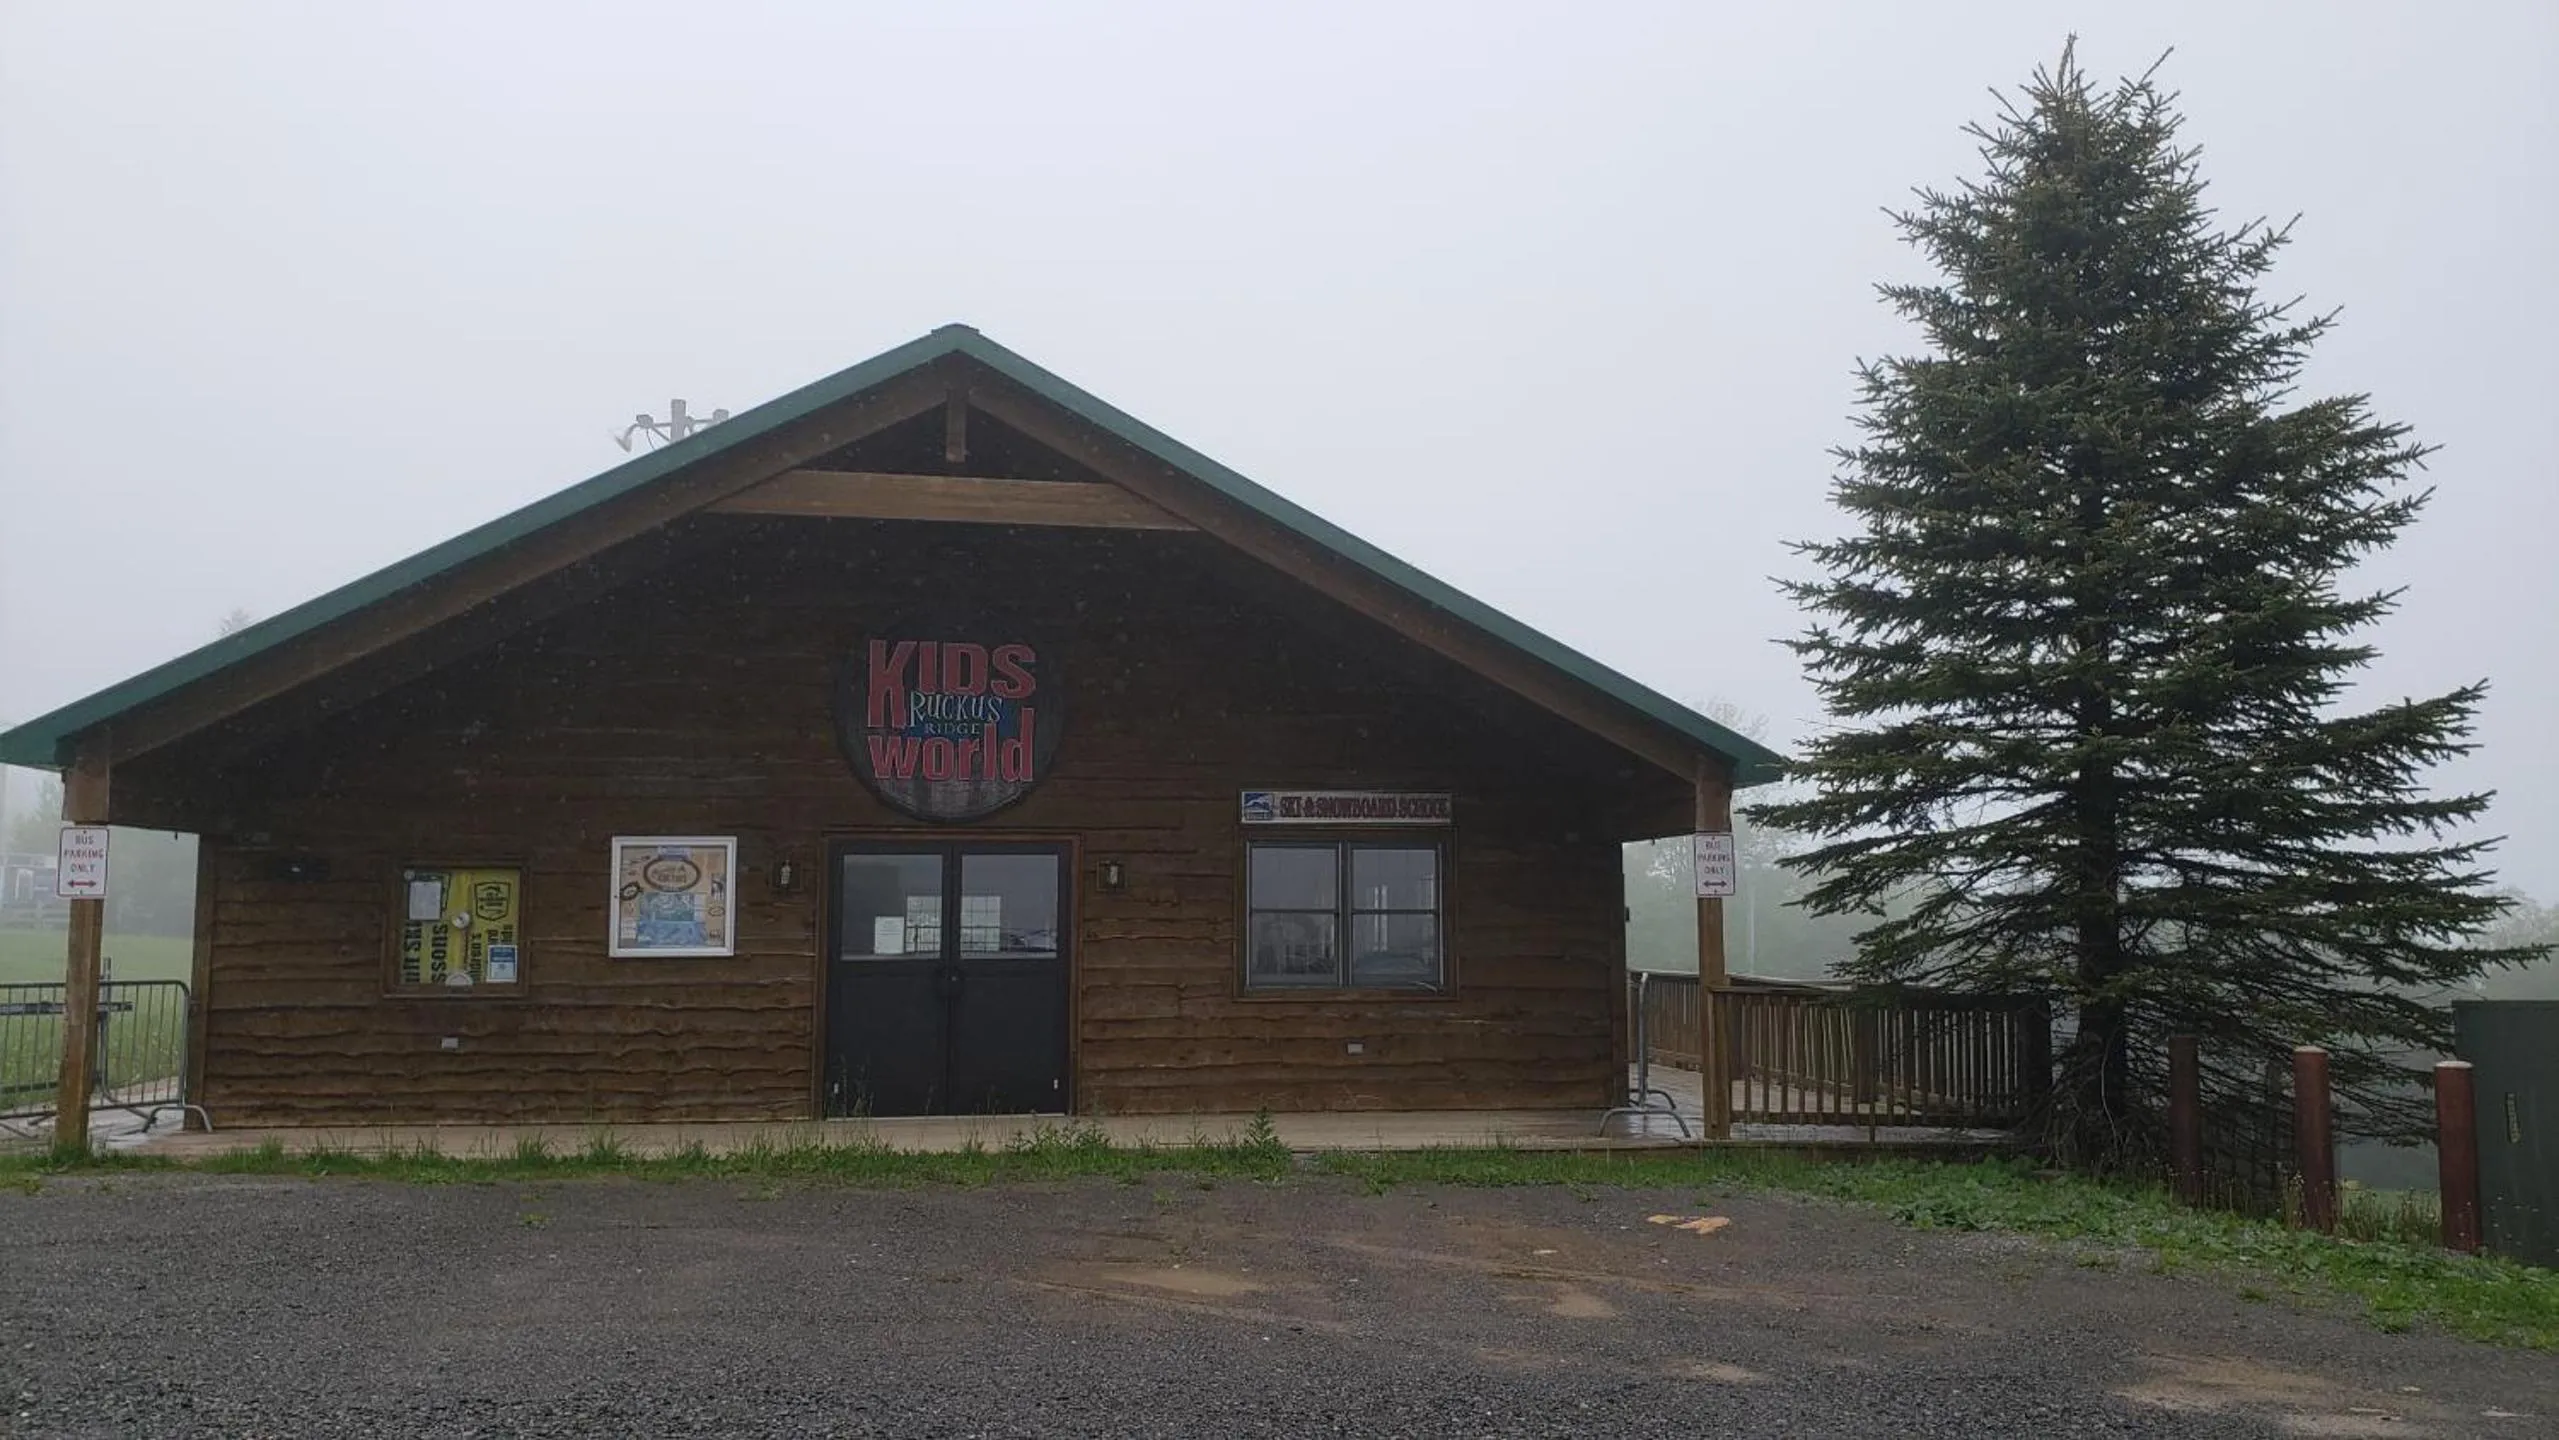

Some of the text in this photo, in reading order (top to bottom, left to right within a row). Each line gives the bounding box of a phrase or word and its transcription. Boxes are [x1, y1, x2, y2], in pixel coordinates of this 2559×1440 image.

[868, 639, 1037, 728] KIDS
[924, 722, 982, 735] RIDGE
[867, 707, 1036, 782] world
[1279, 796, 1302, 818] SKI
[1303, 797, 1314, 818] &
[1315, 796, 1397, 818] SNOWBOARD
[1399, 797, 1448, 819] SCHOOL
[75, 835, 95, 845] BUS
[1705, 841, 1721, 849] BUS
[64, 848, 105, 859] PARKING
[1697, 853, 1731, 862] PARKING
[71, 863, 96, 873] ONLY
[1704, 866, 1725, 874] ONLY
